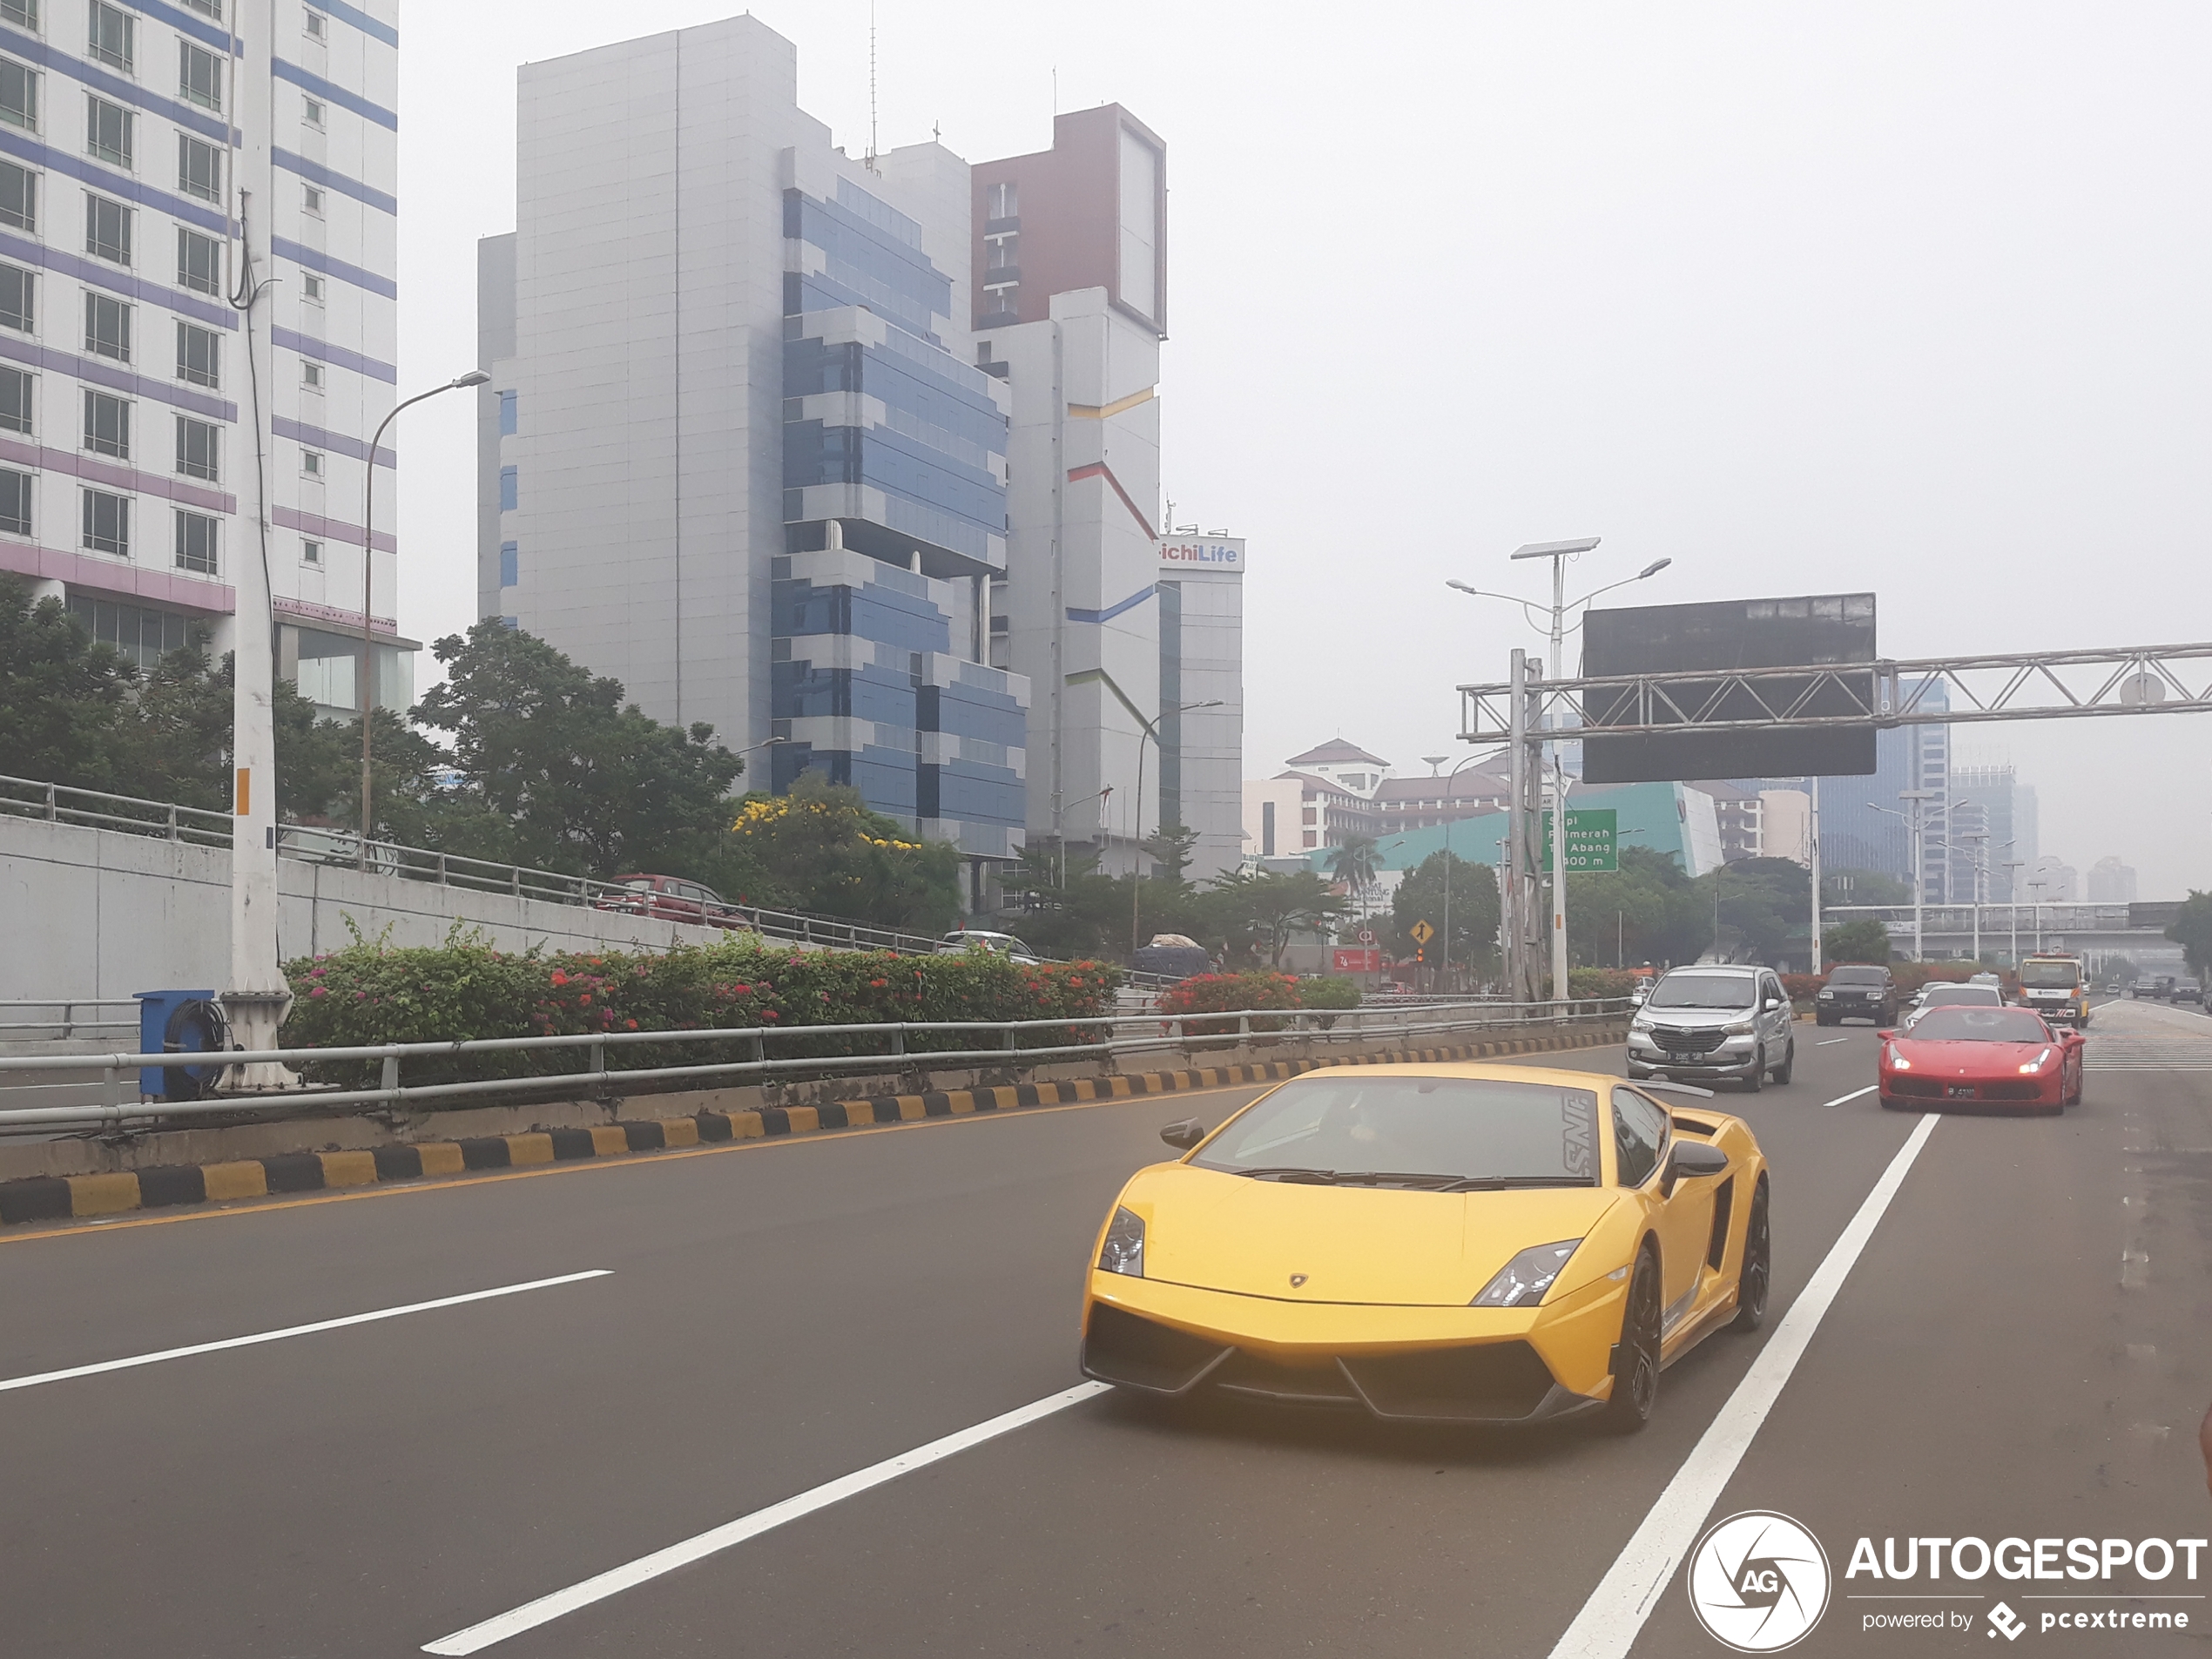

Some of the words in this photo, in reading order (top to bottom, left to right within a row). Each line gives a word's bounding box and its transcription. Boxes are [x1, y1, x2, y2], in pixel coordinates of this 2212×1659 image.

[1548, 816, 1578, 826] Spi
[1548, 829, 1609, 839] Plmerah
[1570, 843, 1610, 853] Abang
